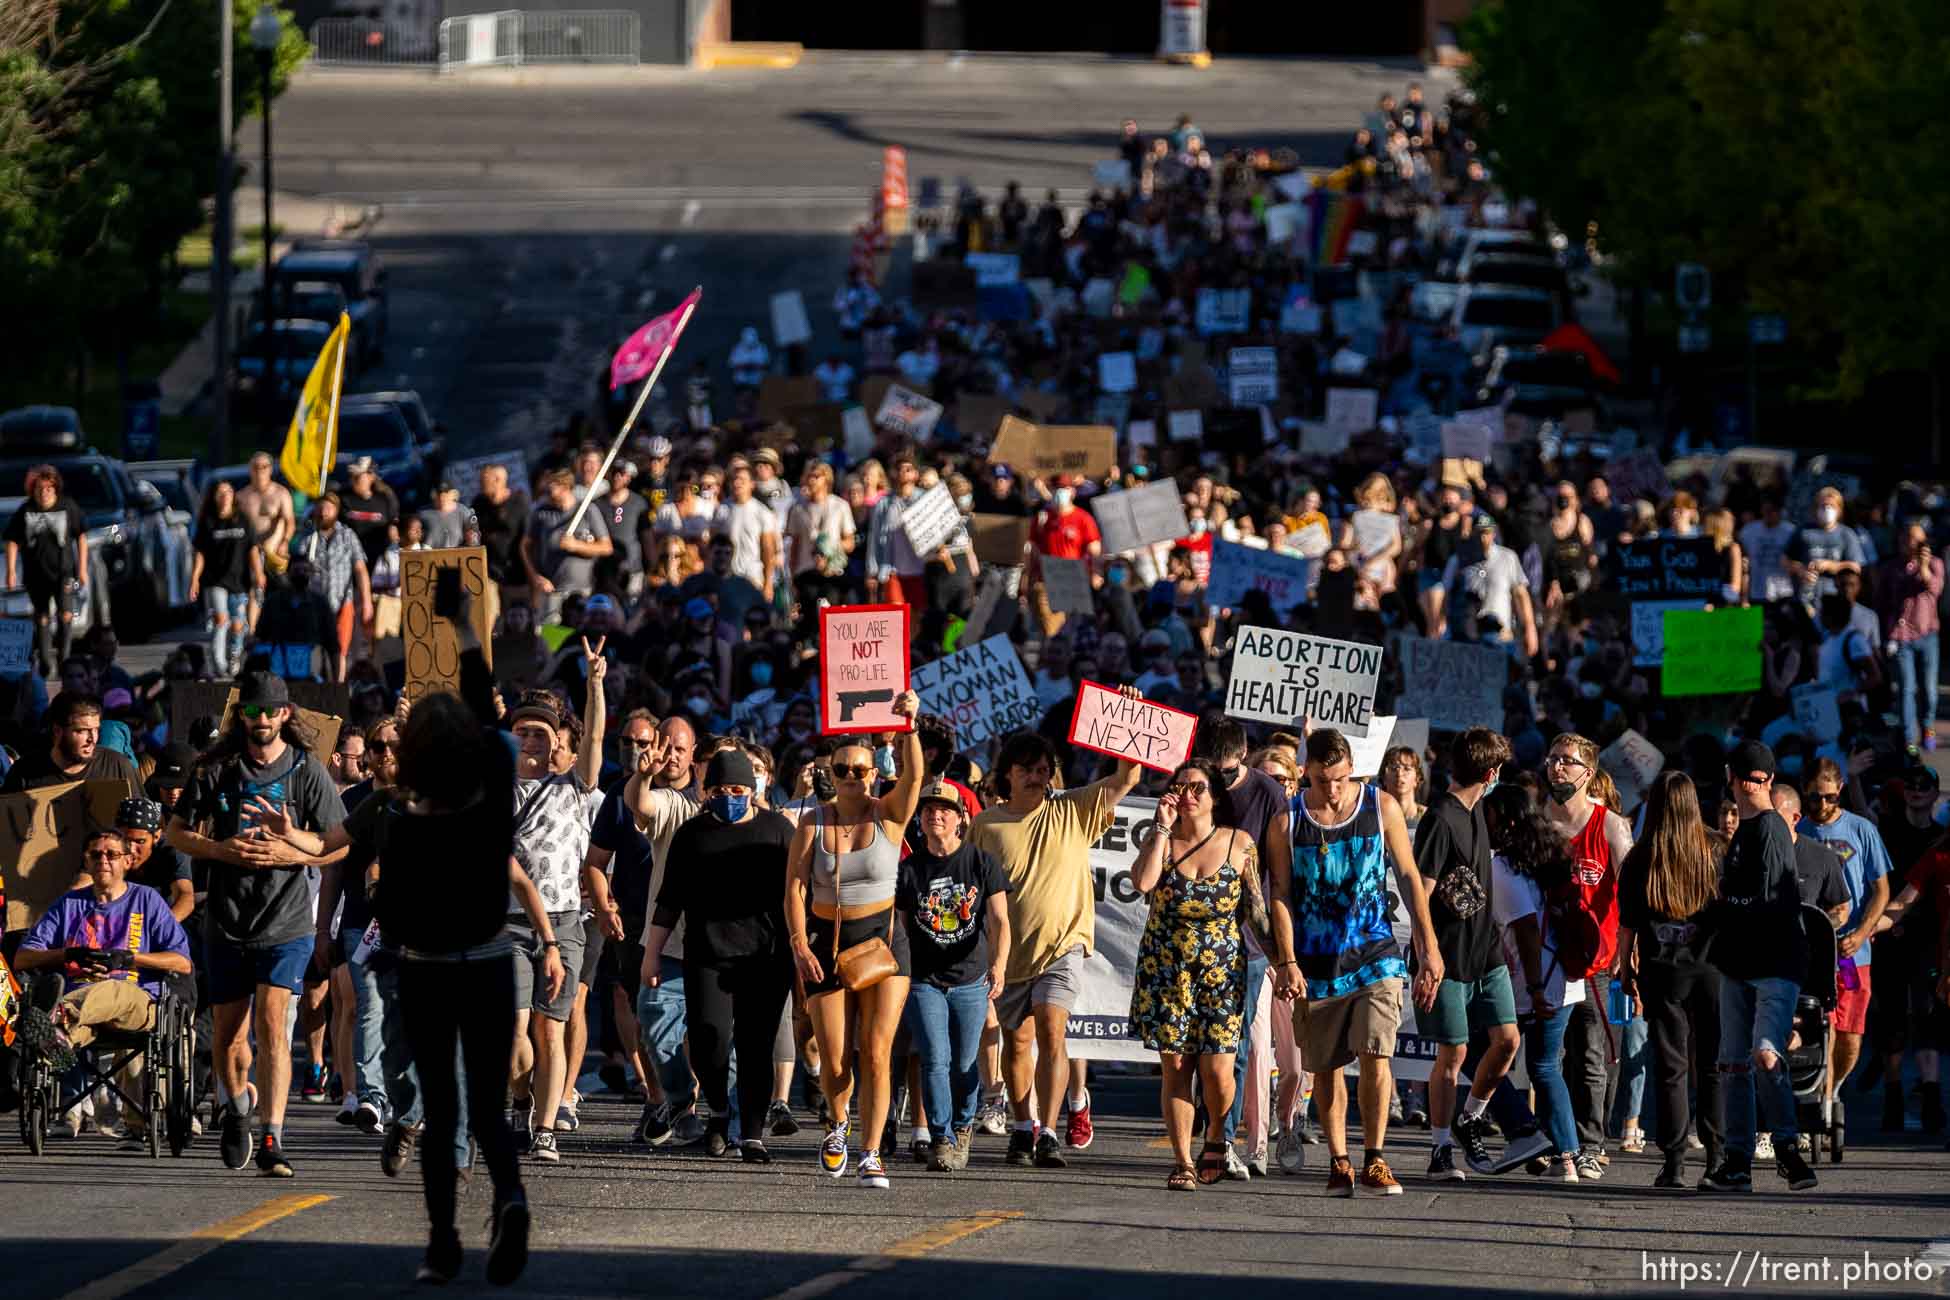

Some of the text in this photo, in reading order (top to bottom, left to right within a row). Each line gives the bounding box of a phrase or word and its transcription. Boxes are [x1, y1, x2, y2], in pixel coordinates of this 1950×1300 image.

[833, 620, 889, 640] YOU ARE
[852, 640, 883, 661] NOT
[408, 639, 459, 679] OU
[840, 663, 889, 681] PRO-LIFE
[912, 643, 998, 693] I AM A
[1240, 630, 1379, 676] ABORTION
[922, 659, 1018, 714] WOMAN
[1281, 664, 1320, 688] IS
[943, 684, 1019, 727] NOT AN
[953, 695, 1044, 748] NCUBATOR
[1100, 691, 1172, 736] WHAT'S
[1231, 679, 1373, 727] HEALTHCARE
[1088, 717, 1170, 762] NEXT?
[1404, 1039, 1417, 1054] &
